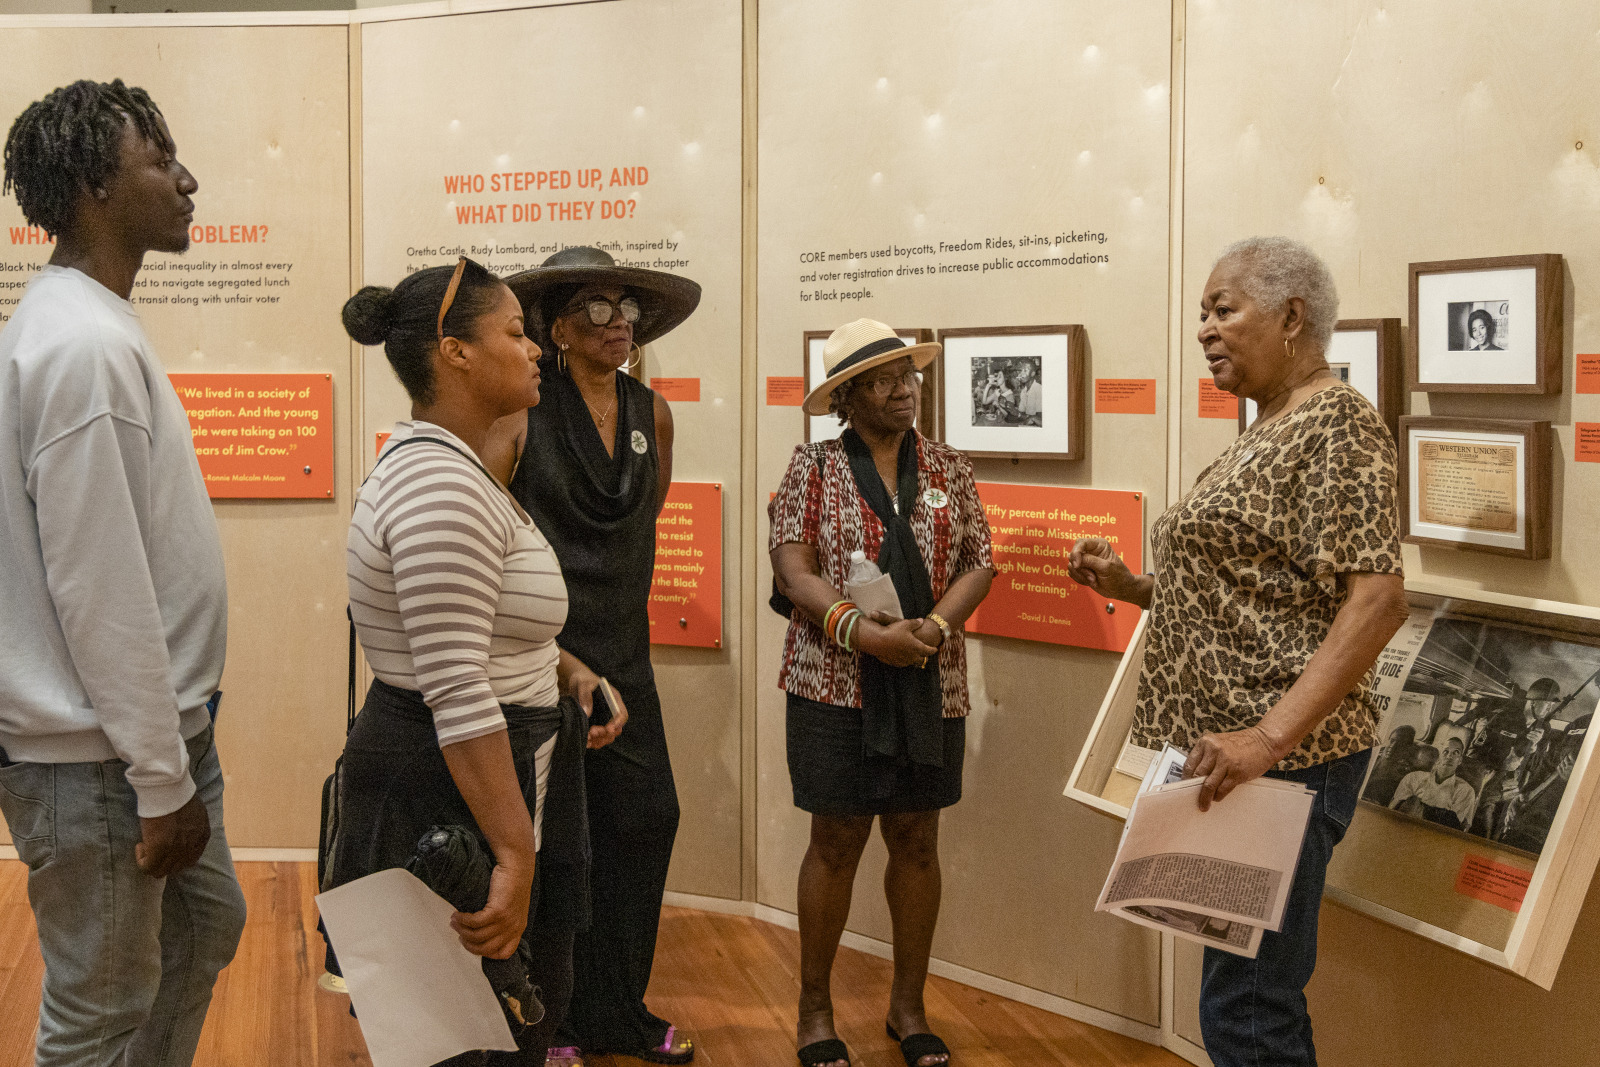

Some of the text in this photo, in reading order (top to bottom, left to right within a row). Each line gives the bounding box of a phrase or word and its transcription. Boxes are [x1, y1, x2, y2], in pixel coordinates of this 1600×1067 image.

[444, 166, 649, 194] WHO STEPPED UP, AND
[456, 199, 637, 224] WHAT DID THEY DO?
[9, 225, 268, 245] WHA OBLEM?
[407, 246, 437, 257] Oretha
[440, 245, 468, 256] Castle,
[471, 244, 493, 257] Rudy
[496, 242, 537, 255] Lombard,
[540, 242, 557, 254] and
[596, 240, 624, 252] Smith,
[626, 240, 664, 253] inspired
[666, 239, 679, 252] by
[800, 230, 1108, 263] CORE members used boycotts, Freedom Rides, sit-ins, picketing,
[139, 261, 166, 271] acial
[169, 260, 217, 273] inequality
[219, 261, 229, 270] in
[231, 260, 263, 270] almost
[265, 262, 293, 272] every
[653, 257, 690, 270] chapter
[800, 252, 1109, 282] and voter registration drives to increase public accommodations
[150, 279, 160, 287] to
[162, 279, 205, 289] navigate
[207, 277, 262, 289] segregated
[264, 277, 290, 287] lunch
[139, 295, 168, 304] transit
[171, 295, 199, 306] along
[202, 295, 222, 304] with
[224, 294, 253, 304] unfair
[255, 295, 280, 303] voter
[800, 287, 874, 302] for Black people.
[205, 387, 232, 398] lived
[234, 388, 245, 398] in
[257, 387, 296, 401] society
[298, 387, 311, 398] of
[238, 407, 261, 417] And
[263, 407, 281, 417] the
[283, 409, 319, 420] young
[210, 428, 239, 436] were
[241, 425, 276, 439] taking
[278, 428, 293, 436] on
[296, 426, 317, 436] 100
[194, 443, 298, 456] ears of Jim Crow.”
[1439, 445, 1472, 453] WESTERN
[1473, 447, 1498, 455] UNION
[664, 502, 693, 510] across
[678, 515, 693, 526] the
[1008, 508, 1046, 519] percent
[1047, 509, 1059, 520] of
[1060, 509, 1077, 521] the
[1079, 513, 1117, 526] people
[660, 531, 694, 541] to resist
[1000, 526, 1024, 535] went
[1025, 526, 1045, 537] into
[1104, 535, 1119, 544] on
[693, 548, 703, 557] to
[1033, 545, 1060, 557] Rides
[673, 563, 705, 575] mainly
[1016, 562, 1040, 573] New
[657, 576, 671, 586] the
[673, 577, 698, 588] Black
[1011, 578, 1026, 589] for
[1049, 616, 1072, 626] Dennis
[1379, 661, 1404, 678] RIDE
